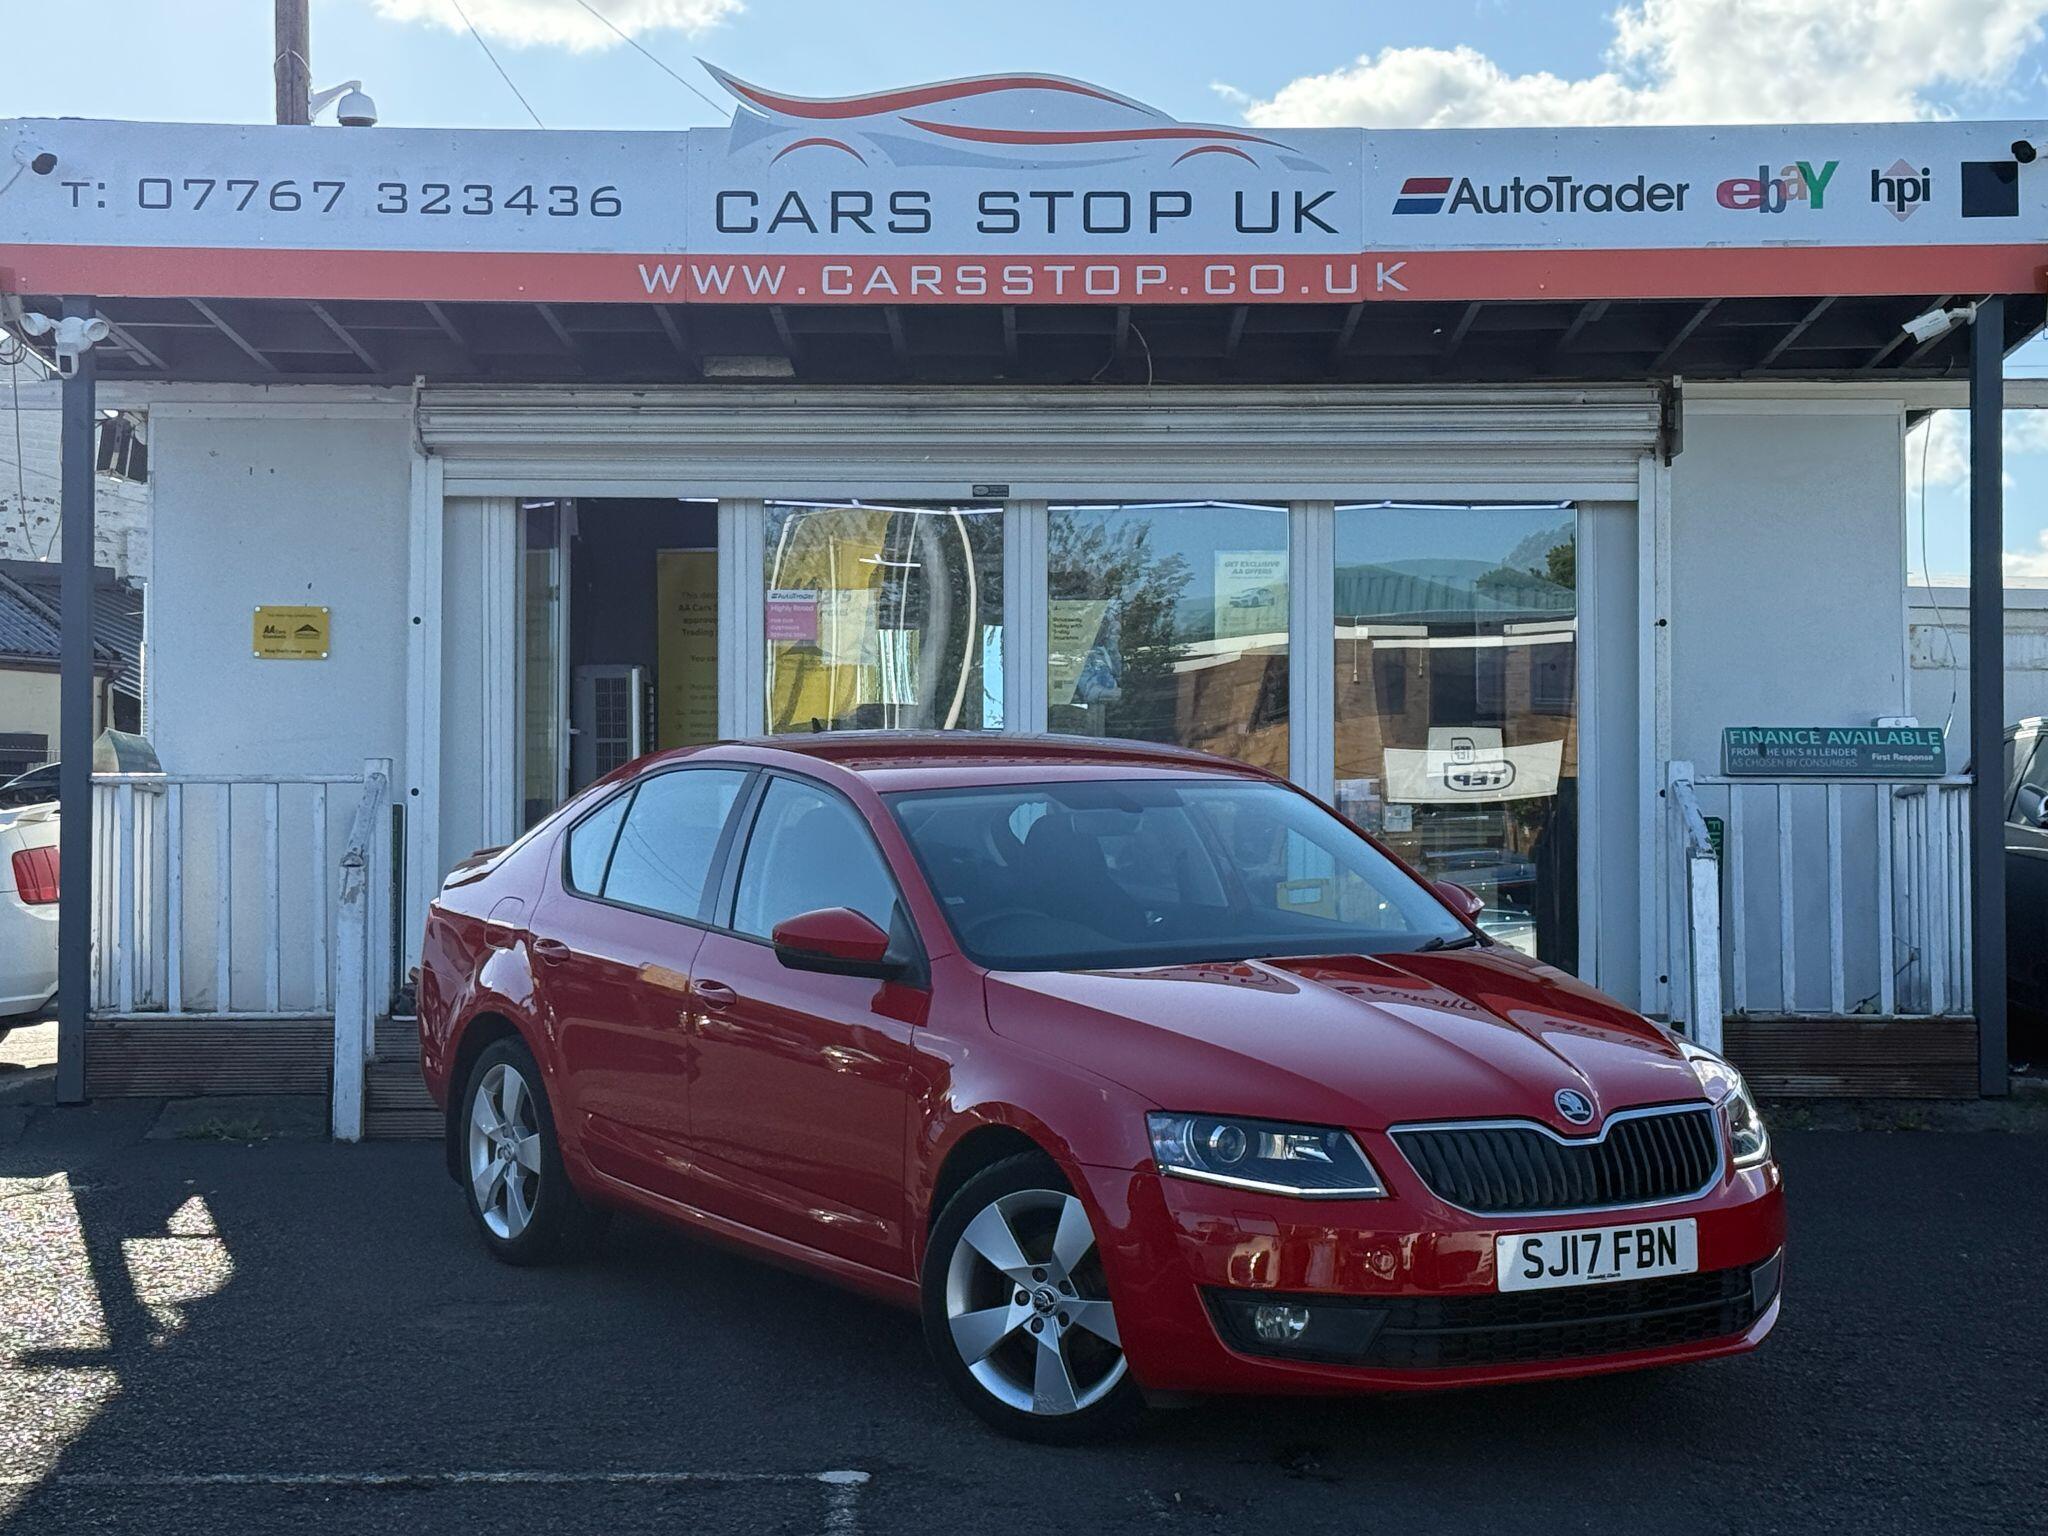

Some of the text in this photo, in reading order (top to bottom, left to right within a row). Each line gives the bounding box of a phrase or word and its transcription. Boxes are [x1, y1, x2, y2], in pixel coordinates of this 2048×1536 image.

[61, 178, 624, 217] T: 07767 323436
[1449, 175, 1690, 214] AutoTrader
[1871, 167, 1931, 212] hpi
[716, 190, 1340, 234] CARS STOP UK
[638, 260, 1408, 297] WWW.CARSSTOP.CO.UK
[1729, 730, 1941, 746] FINANCE AVAILABLE
[1731, 748, 1759, 757] FROM
[1782, 748, 1804, 757] UK'S
[1820, 747, 1858, 757] LENDER
[1745, 758, 1784, 768] CHOSEN
[1800, 758, 1859, 769] CONSUMERS
[1872, 753, 1934, 762] First Response
[1522, 1225, 1677, 1279] SJ17 FBN
